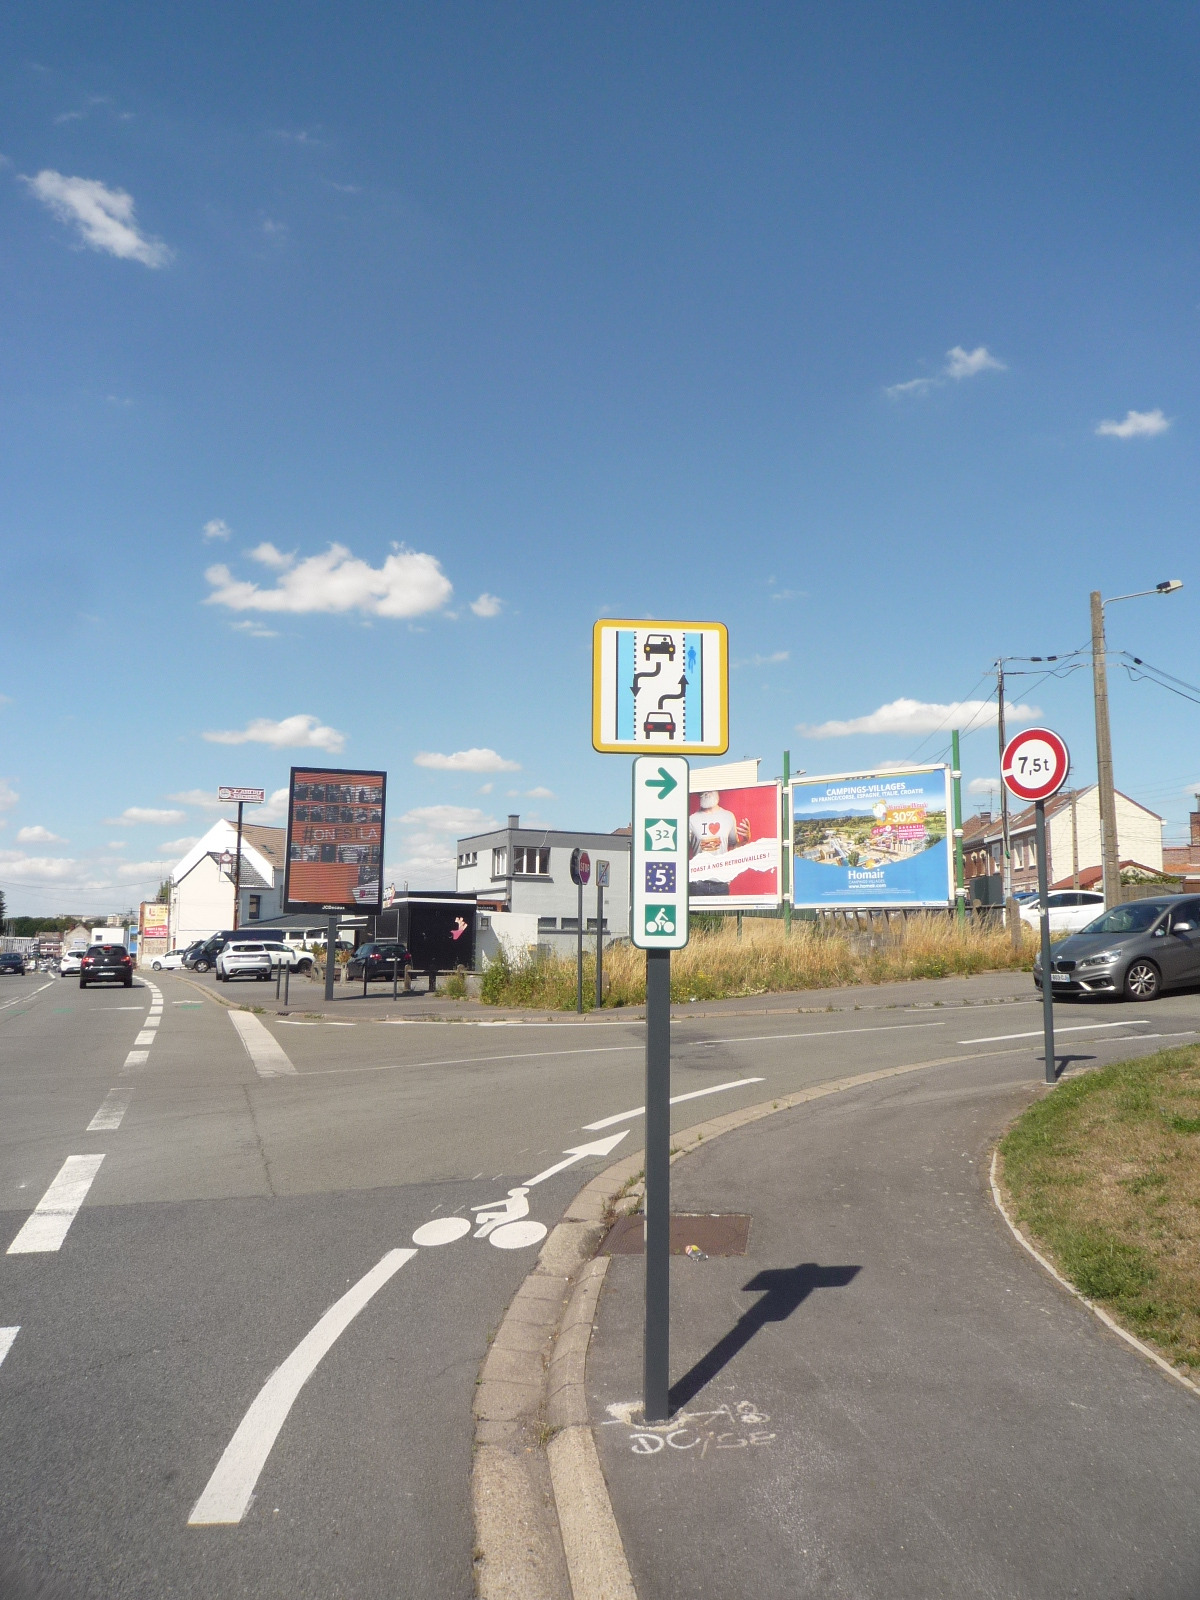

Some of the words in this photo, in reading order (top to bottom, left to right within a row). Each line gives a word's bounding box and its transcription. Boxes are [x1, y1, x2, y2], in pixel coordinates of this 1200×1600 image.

[1018, 756, 1050, 776] 7,5t
[826, 782, 906, 796] CAMPINGS-VILLAGES
[655, 829, 670, 841] 32
[724, 853, 767, 866] RETROUVAILLES
[655, 869, 667, 886] 5
[848, 868, 885, 880] Homair
